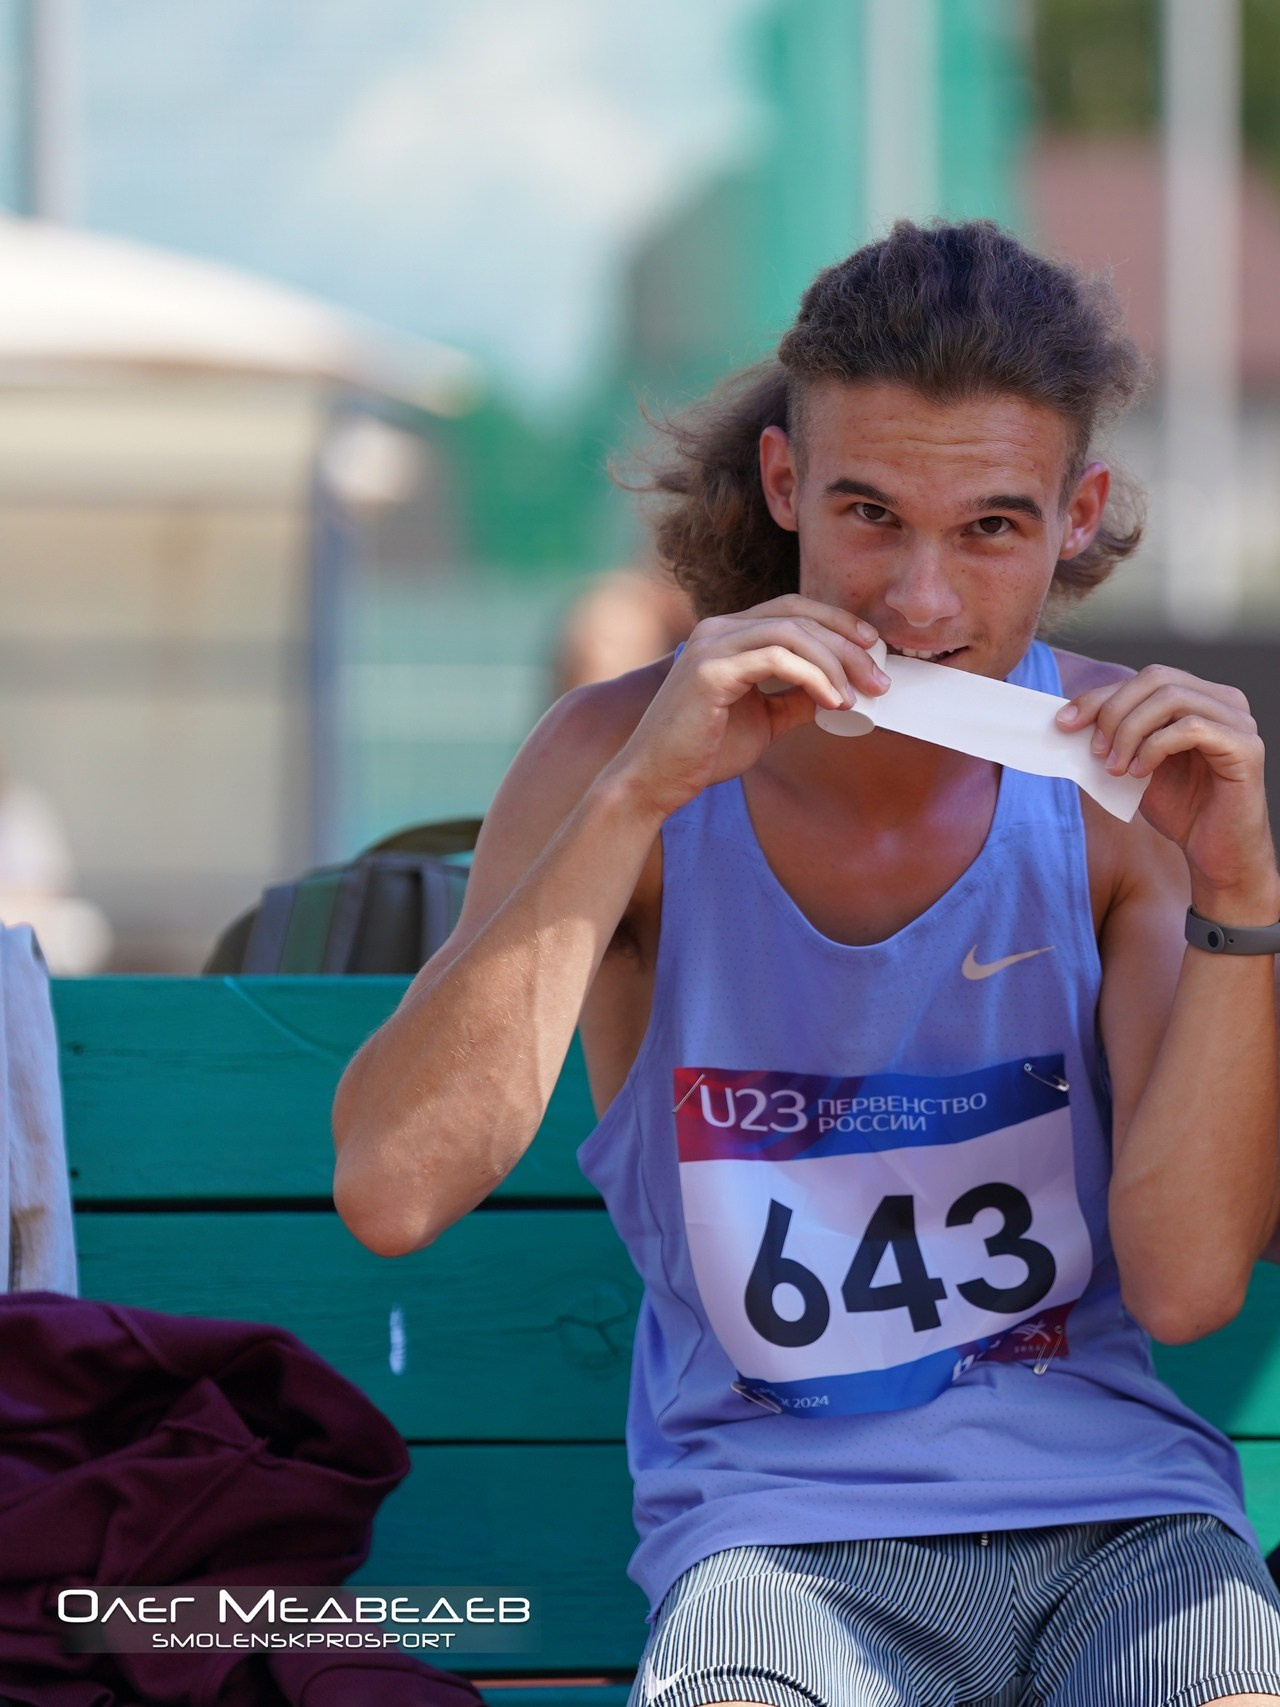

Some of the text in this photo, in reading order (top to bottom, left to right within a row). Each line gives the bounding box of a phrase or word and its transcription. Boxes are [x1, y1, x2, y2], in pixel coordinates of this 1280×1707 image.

[700, 1084, 808, 1133] U23
[818, 1092, 987, 1116] ПЕРВЕНСТВО
[818, 1114, 927, 1133] РОССИИ
[744, 1182, 1057, 1348] 643
[793, 1395, 829, 1409] 2024
